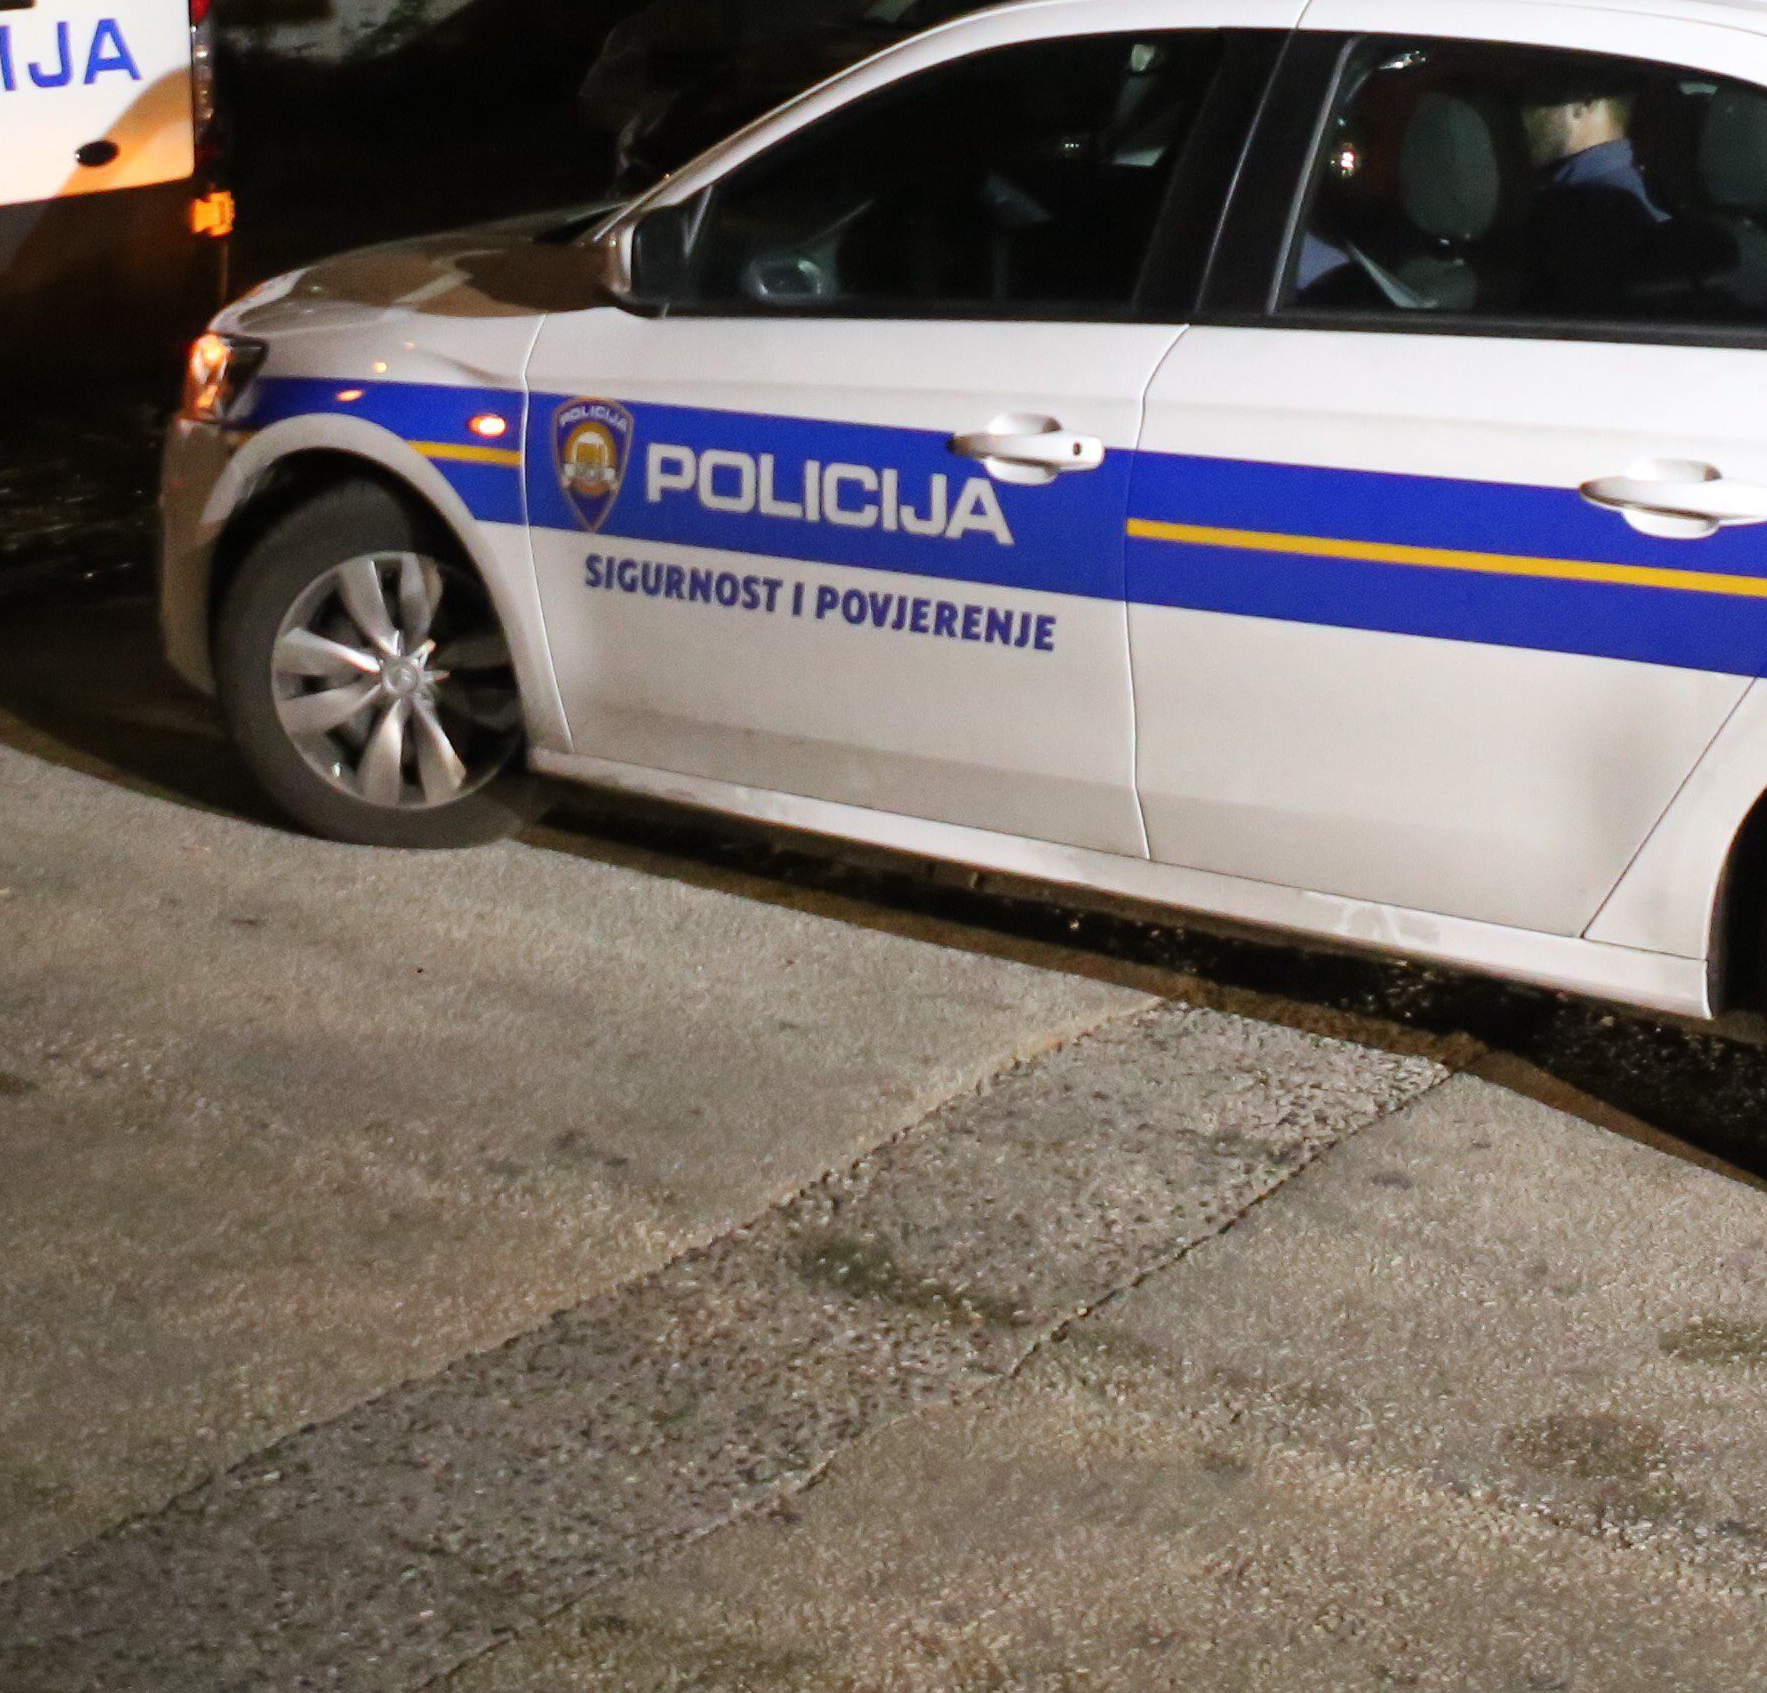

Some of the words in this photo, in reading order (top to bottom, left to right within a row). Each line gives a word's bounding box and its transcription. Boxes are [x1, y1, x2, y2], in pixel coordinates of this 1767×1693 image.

[646, 442, 1015, 546] POLICIJA
[585, 553, 783, 616] SIGURNOST
[792, 580, 805, 616] I
[816, 584, 1058, 652] POVJERENJE
